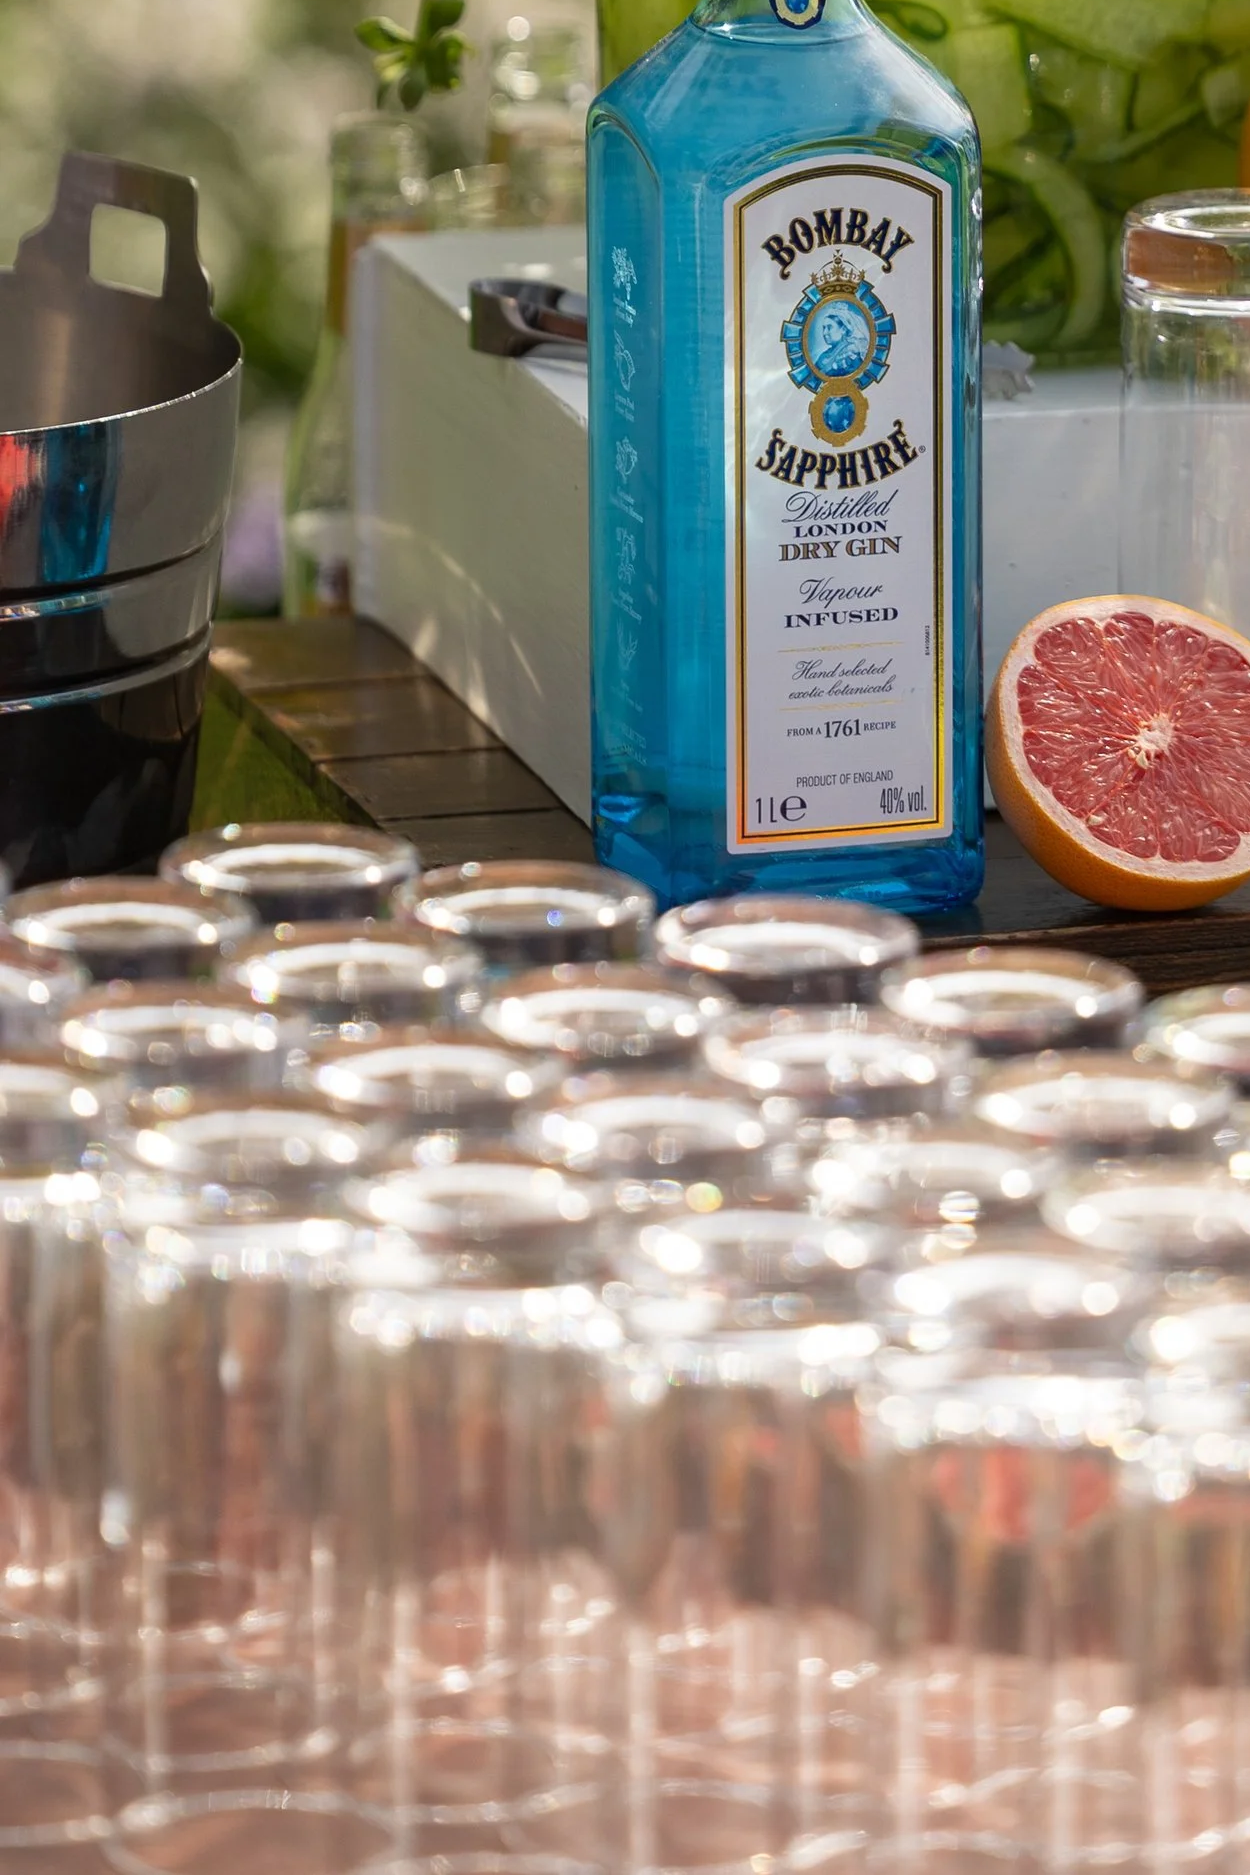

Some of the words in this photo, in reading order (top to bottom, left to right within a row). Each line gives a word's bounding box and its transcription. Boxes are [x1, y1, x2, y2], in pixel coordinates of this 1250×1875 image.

[760, 206, 916, 282] BOMBAY
[781, 489, 899, 523] Distilled
[793, 520, 889, 539] LONDON
[778, 541, 841, 562] DRY
[845, 536, 903, 557] GIN
[799, 576, 884, 609] Vapour
[783, 607, 899, 629] INFUSED
[791, 658, 843, 681] Hand
[838, 658, 893, 677] selected
[788, 686, 825, 700] exotic
[826, 674, 897, 697] botanicals
[786, 727, 814, 738] FROM
[815, 728, 822, 736] A
[824, 718, 862, 739] 1761
[863, 720, 897, 732] RECIPE
[796, 773, 837, 788] PRODUCT
[839, 772, 852, 786] OF
[853, 769, 894, 784] ENGLAND
[879, 786, 904, 814] 40%
[907, 784, 928, 813] vol.
